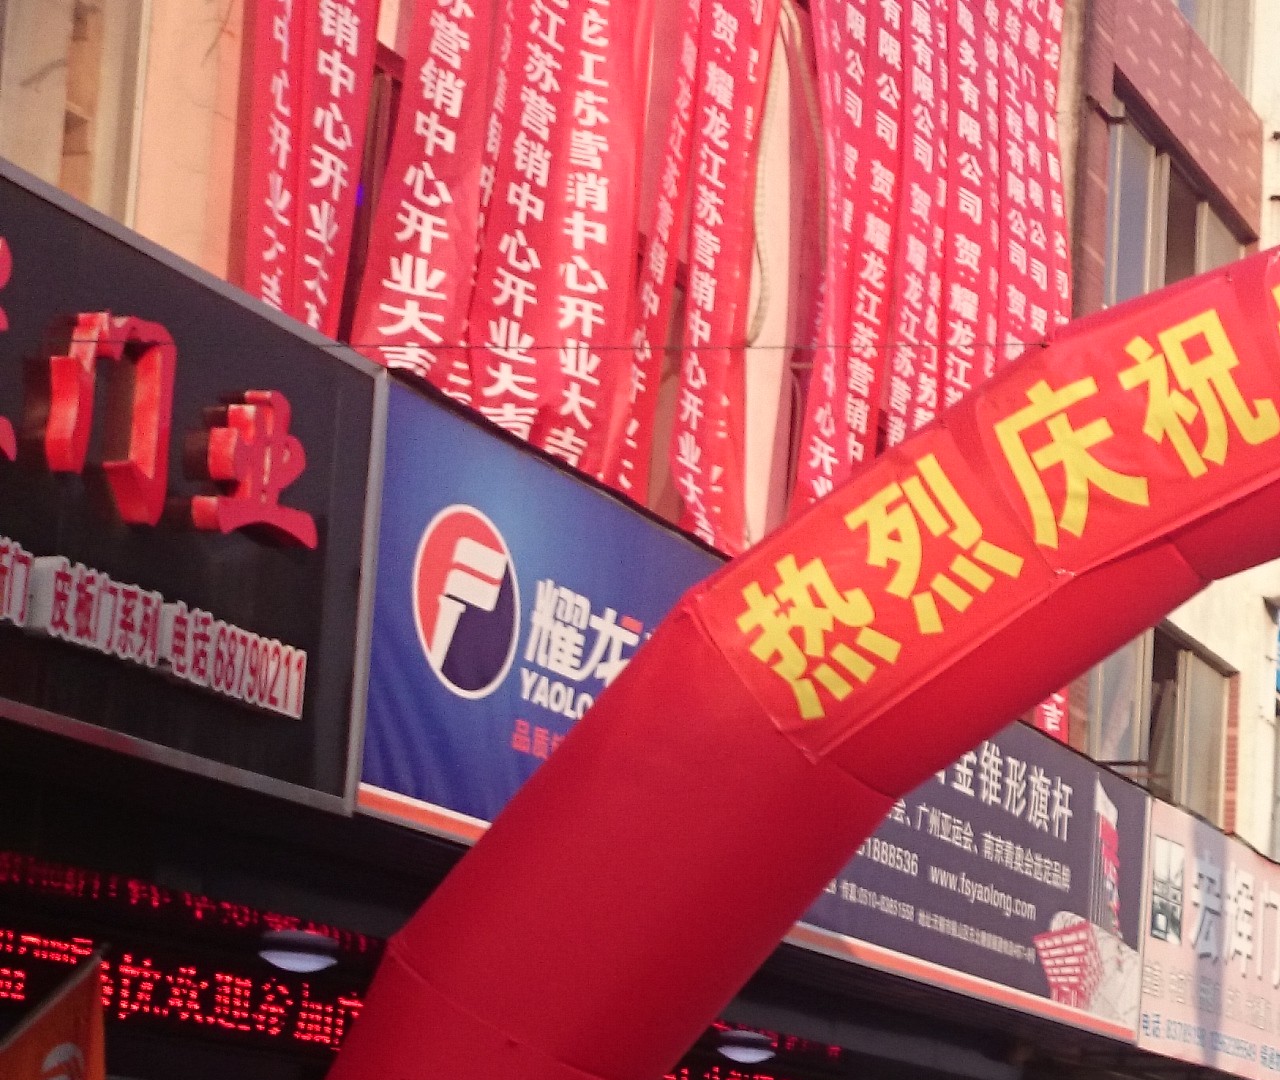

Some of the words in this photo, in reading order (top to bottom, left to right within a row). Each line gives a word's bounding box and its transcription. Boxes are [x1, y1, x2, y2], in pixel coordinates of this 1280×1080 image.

[936, 740, 1073, 842] 金锥形旗杆
